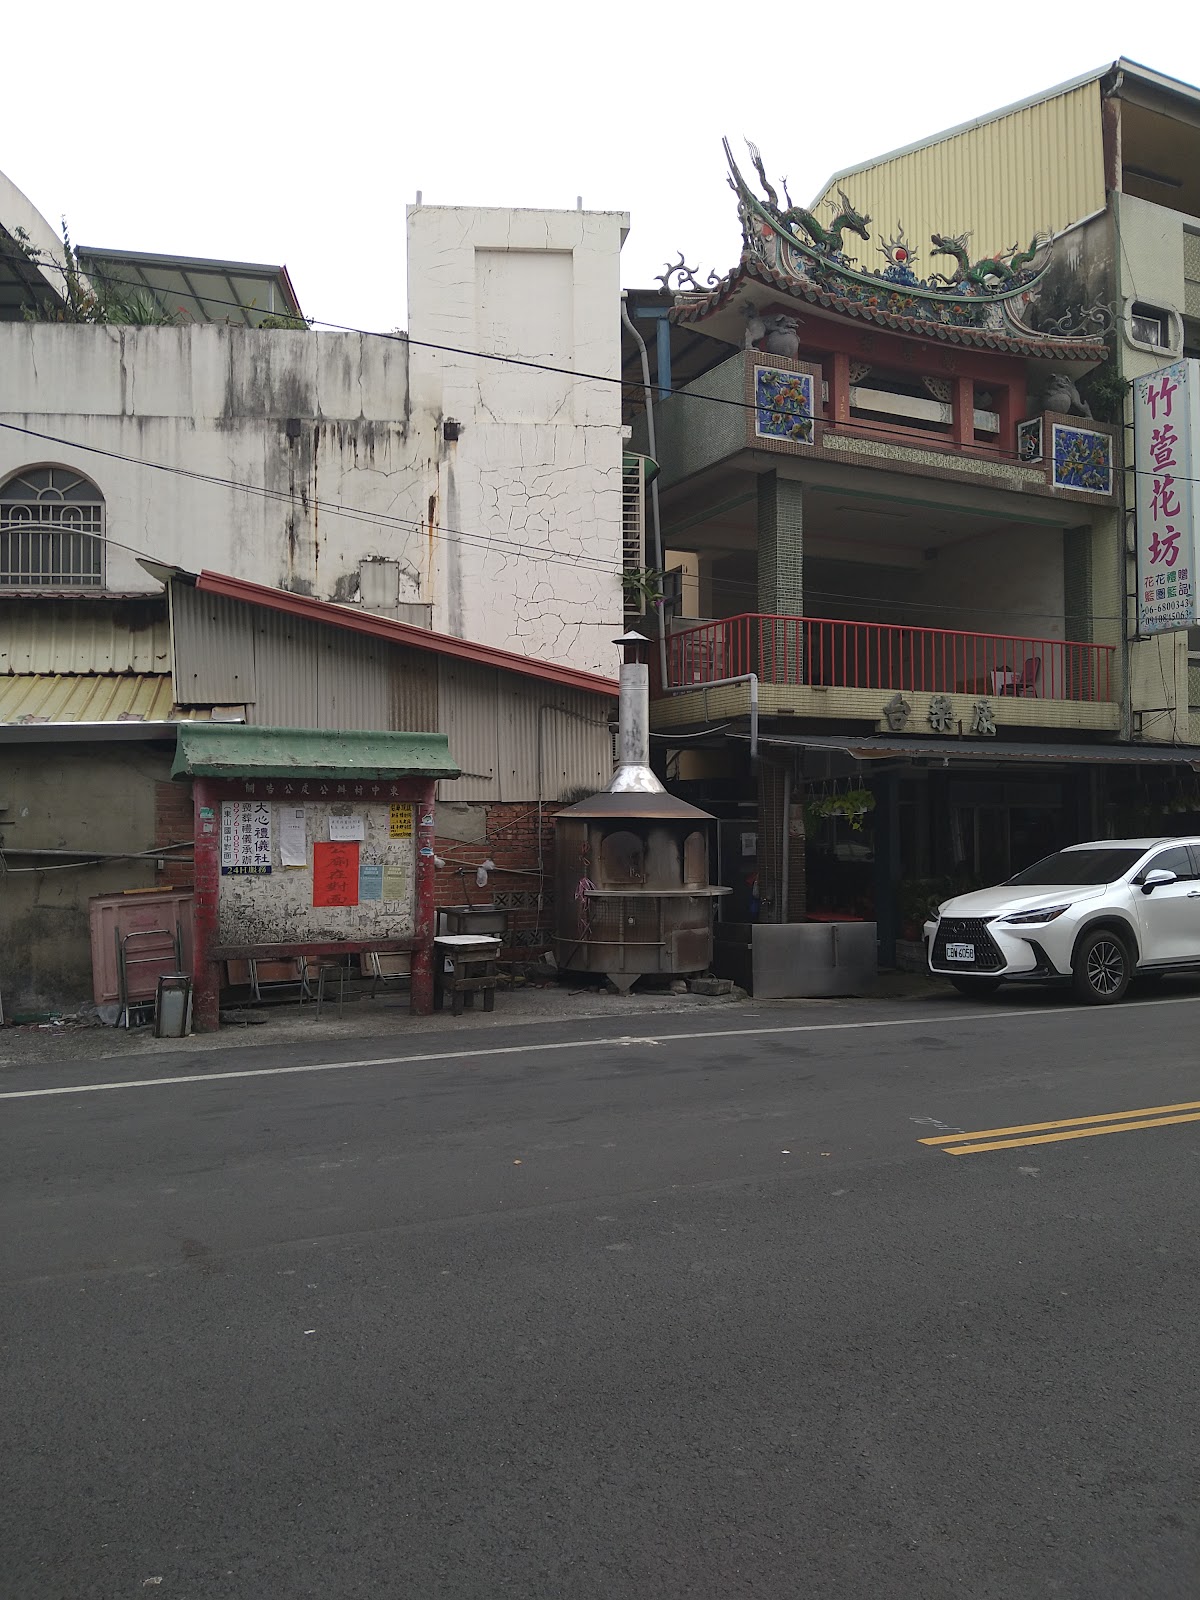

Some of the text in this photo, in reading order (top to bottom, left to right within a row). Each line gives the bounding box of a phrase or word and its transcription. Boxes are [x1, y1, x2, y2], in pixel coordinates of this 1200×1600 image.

[1147, 377, 1181, 567] 竹萱花坊
[1145, 598, 1189, 615] 06-6800343
[254, 802, 270, 864] 大心禮儀社
